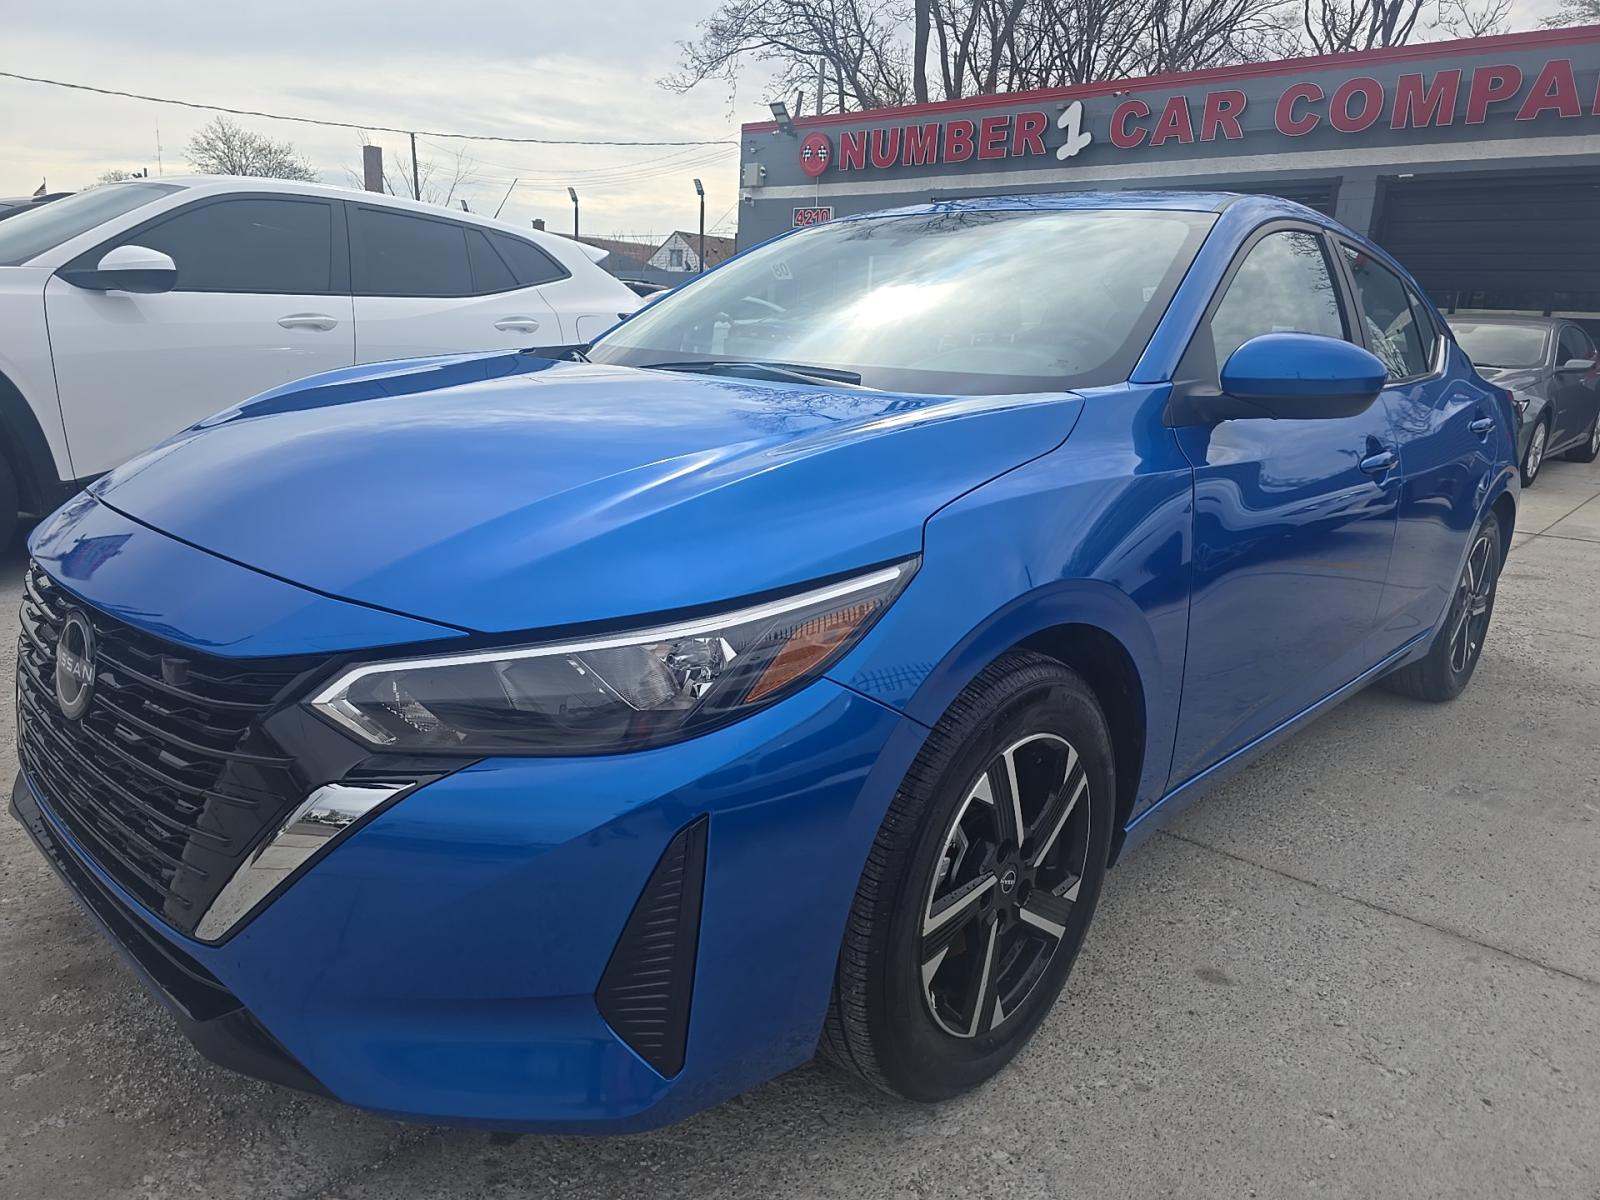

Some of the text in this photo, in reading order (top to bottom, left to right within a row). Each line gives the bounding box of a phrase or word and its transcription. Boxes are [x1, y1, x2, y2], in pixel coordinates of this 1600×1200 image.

[838, 58, 1600, 171] NUMBER 1 CAR COMPA
[795, 209, 830, 226] 4210
[60, 650, 93, 682] SSAN
